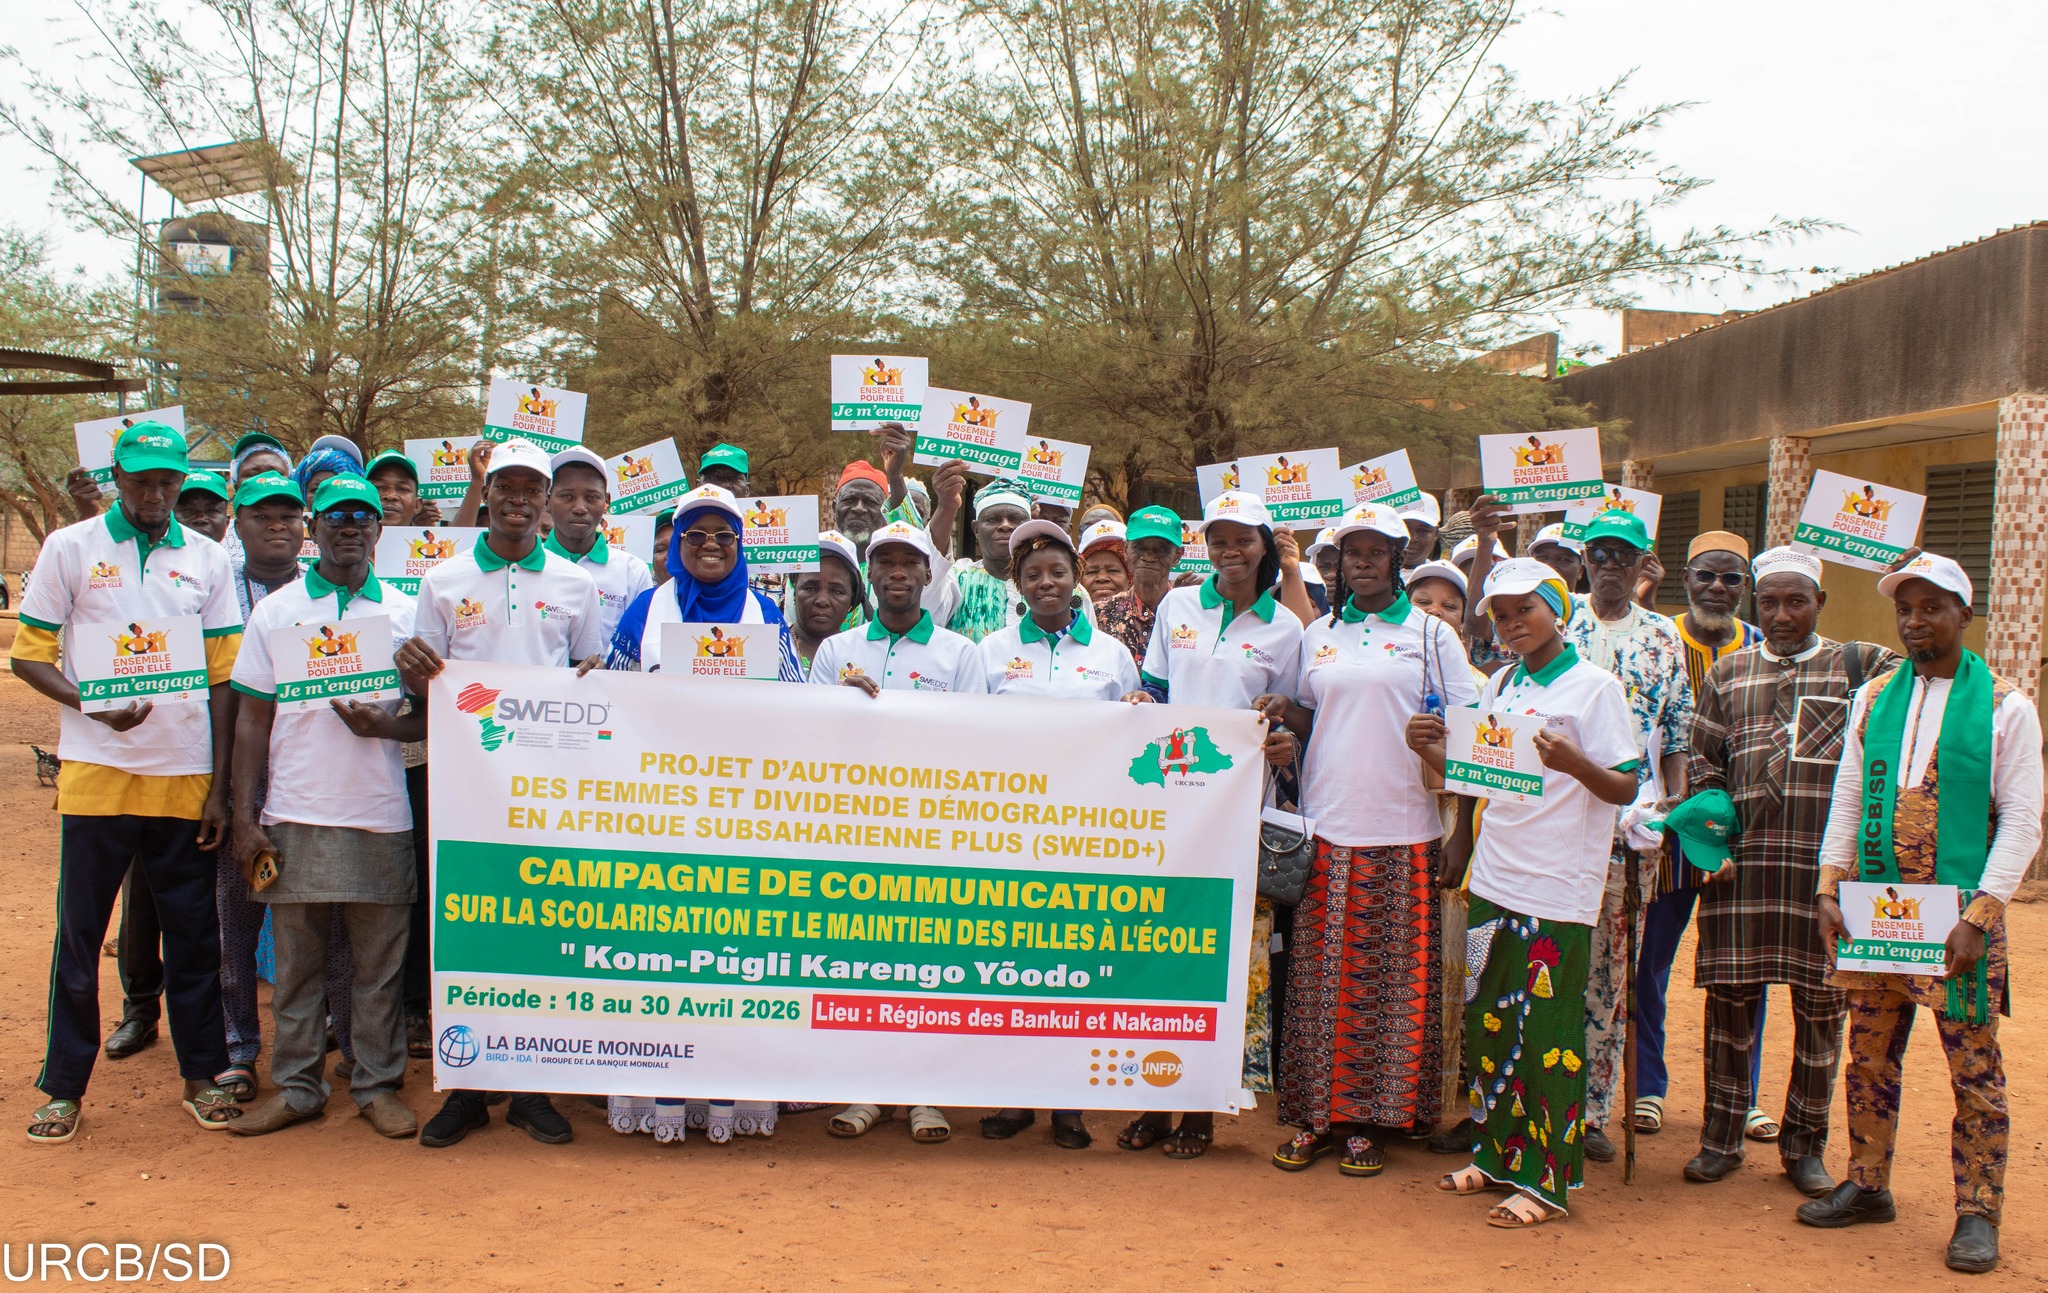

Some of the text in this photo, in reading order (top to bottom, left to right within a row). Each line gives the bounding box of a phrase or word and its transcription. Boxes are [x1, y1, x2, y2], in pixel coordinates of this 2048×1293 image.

[860, 387, 904, 395] ENSEMBLE
[860, 394, 884, 402] POUR
[834, 405, 853, 418] Je
[512, 420, 556, 435] POUR ELLE
[513, 413, 556, 428] ENSEMBLE
[486, 427, 506, 442] Je
[948, 423, 996, 438] ENSEMBLE
[946, 431, 995, 446] POUR ELLE
[918, 439, 1018, 470] Je m’engage
[1021, 468, 1061, 482] POUR ELLE
[1022, 462, 1062, 474] ENSEMBLE
[1514, 465, 1568, 477] ENSEMBLE
[617, 472, 659, 490] ENSEMBLE
[1514, 473, 1569, 485] POUR ELLE
[620, 478, 660, 497] POUR ELLE
[1265, 484, 1312, 496] ENSEMBLE
[1354, 481, 1392, 498] ENSEMBLE
[1377, 487, 1394, 498] ELLE
[1512, 483, 1601, 501] m’engage
[620, 482, 687, 512] m’engage
[1266, 492, 1312, 502] POUR ELLE
[1835, 512, 1888, 532] ENSEMBLE
[1564, 524, 1582, 537] Je
[1832, 522, 1886, 541] POUR ELLE
[1798, 526, 1902, 564] Je m’engag
[456, 614, 486, 624] ENSEMBLE
[456, 620, 486, 630] POUR ELLE
[113, 654, 171, 667] ENSEMBLE
[306, 655, 362, 669] ENSEMBLE
[692, 658, 746, 667] ENSEMBLE
[114, 663, 172, 676] POUR ELLE
[308, 664, 363, 678] POUR ELLE
[692, 667, 746, 676] POUR ELLE
[82, 674, 205, 697] Je m’engage
[280, 672, 396, 699] Je m’engage
[1472, 745, 1514, 760] ENSEMBLE
[1472, 754, 1514, 770] POUR ELLE
[640, 752, 1048, 794] PROJET D’AUTONOMISATION
[1448, 762, 1540, 792] Je m’engage
[510, 776, 1166, 830] DES FEMMES ET DIVIDENDE DÉMOGRAPHIQUE
[1864, 759, 1887, 876] URCB/SD
[508, 806, 1164, 866] EN AFRIQUE SUBSAHARIENNE PLUS (SWEDD+)
[519, 857, 1166, 913] CAMPAGNE DE COMMUNICATION
[444, 894, 1217, 954] SUR LA SCOLARISATION ET LE MAINTIEN DES FILLES À L'ÉCOLE
[1871, 920, 1924, 931] ENSEMBLE
[1872, 930, 1924, 940] POUR ELLE
[1868, 942, 1946, 962] m’engag
[584, 946, 791, 982] Kom-Pũgli
[800, 953, 966, 988] Karengo
[974, 962, 1090, 988] Yõodo
[446, 984, 542, 1010] Période
[565, 991, 594, 1012] 18
[602, 997, 632, 1014] au
[640, 994, 670, 1016] 30
[678, 996, 733, 1018] Avril
[741, 998, 801, 1020] 2026
[816, 1001, 860, 1024] Lieu
[879, 1003, 961, 1030] Régions
[968, 1005, 1004, 1028] des
[1011, 1008, 1080, 1031] Bankui
[1086, 1010, 1106, 1031] et
[1112, 1010, 1207, 1034] Nakambé
[486, 1036, 694, 1059] LA BANQUE MONDIALE
[486, 1052, 509, 1062] BIRD
[516, 1054, 532, 1063] IDA
[542, 1056, 573, 1065] GROUPE
[586, 1058, 596, 1066] LA
[597, 1059, 628, 1068] BANQUE
[630, 1060, 670, 1069] MONDIALE
[1140, 1062, 1184, 1076] UNFPA
